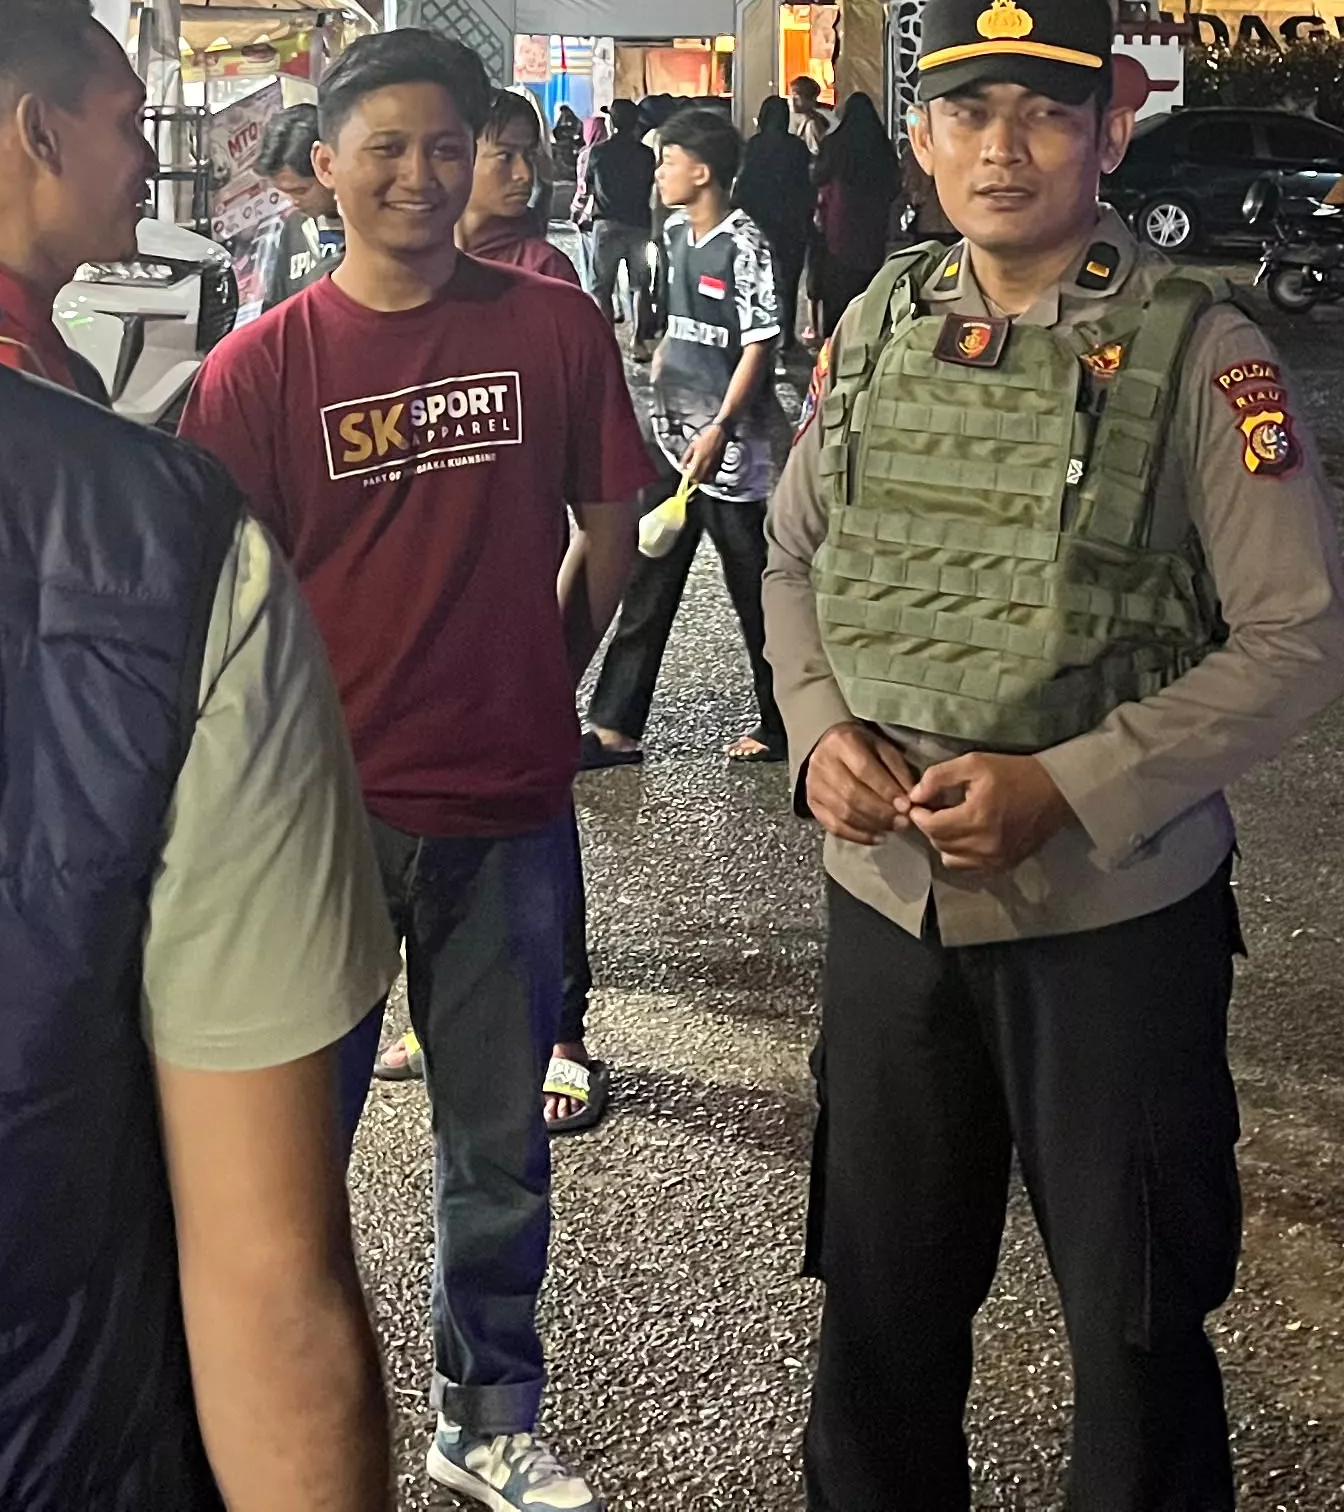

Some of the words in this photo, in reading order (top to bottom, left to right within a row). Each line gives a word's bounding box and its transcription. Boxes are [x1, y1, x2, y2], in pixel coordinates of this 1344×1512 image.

[1218, 363, 1276, 389] POLDA
[1235, 390, 1281, 409] RIAU
[339, 402, 408, 463] SK
[410, 384, 508, 428] SPORT
[411, 417, 511, 448] APPAREL
